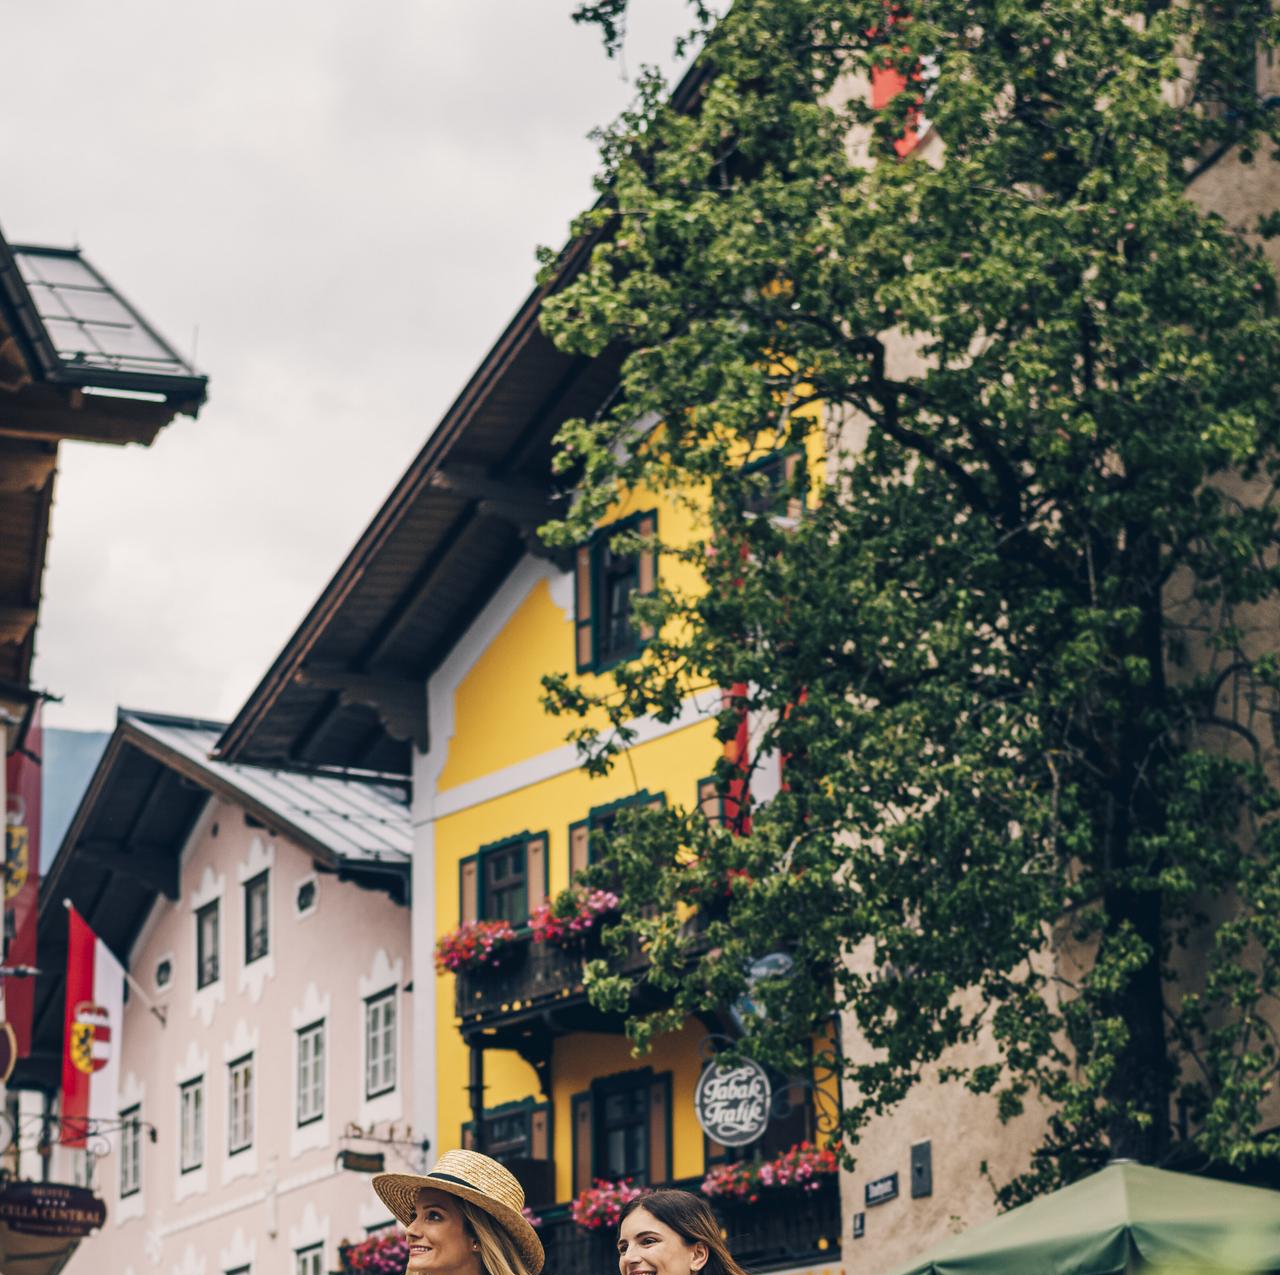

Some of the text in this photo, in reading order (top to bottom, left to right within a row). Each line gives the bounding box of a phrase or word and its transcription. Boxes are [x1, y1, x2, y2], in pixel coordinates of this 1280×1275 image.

[703, 1072, 764, 1104] Tabak
[705, 1100, 764, 1131] Trafik
[0, 1203, 100, 1222] CELLA CENTRAL
